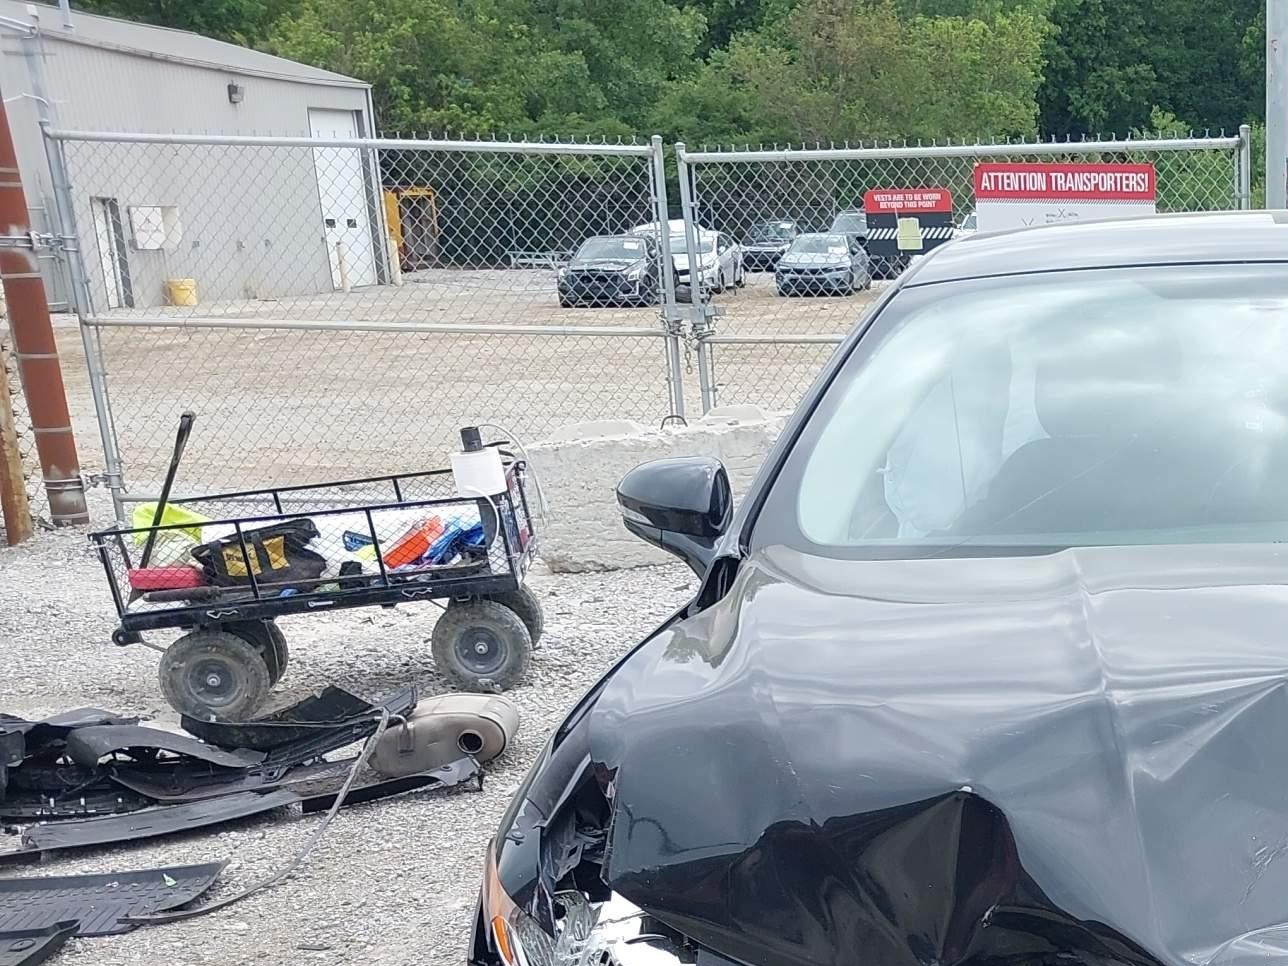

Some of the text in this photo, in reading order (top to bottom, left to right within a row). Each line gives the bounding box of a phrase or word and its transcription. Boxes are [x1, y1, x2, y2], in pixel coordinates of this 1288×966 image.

[981, 172, 1149, 192] ATTENTION TRANSPORTERS!
[873, 194, 891, 202] VESTS
[880, 201, 903, 209] BEYOND
[919, 200, 936, 208] POINT
